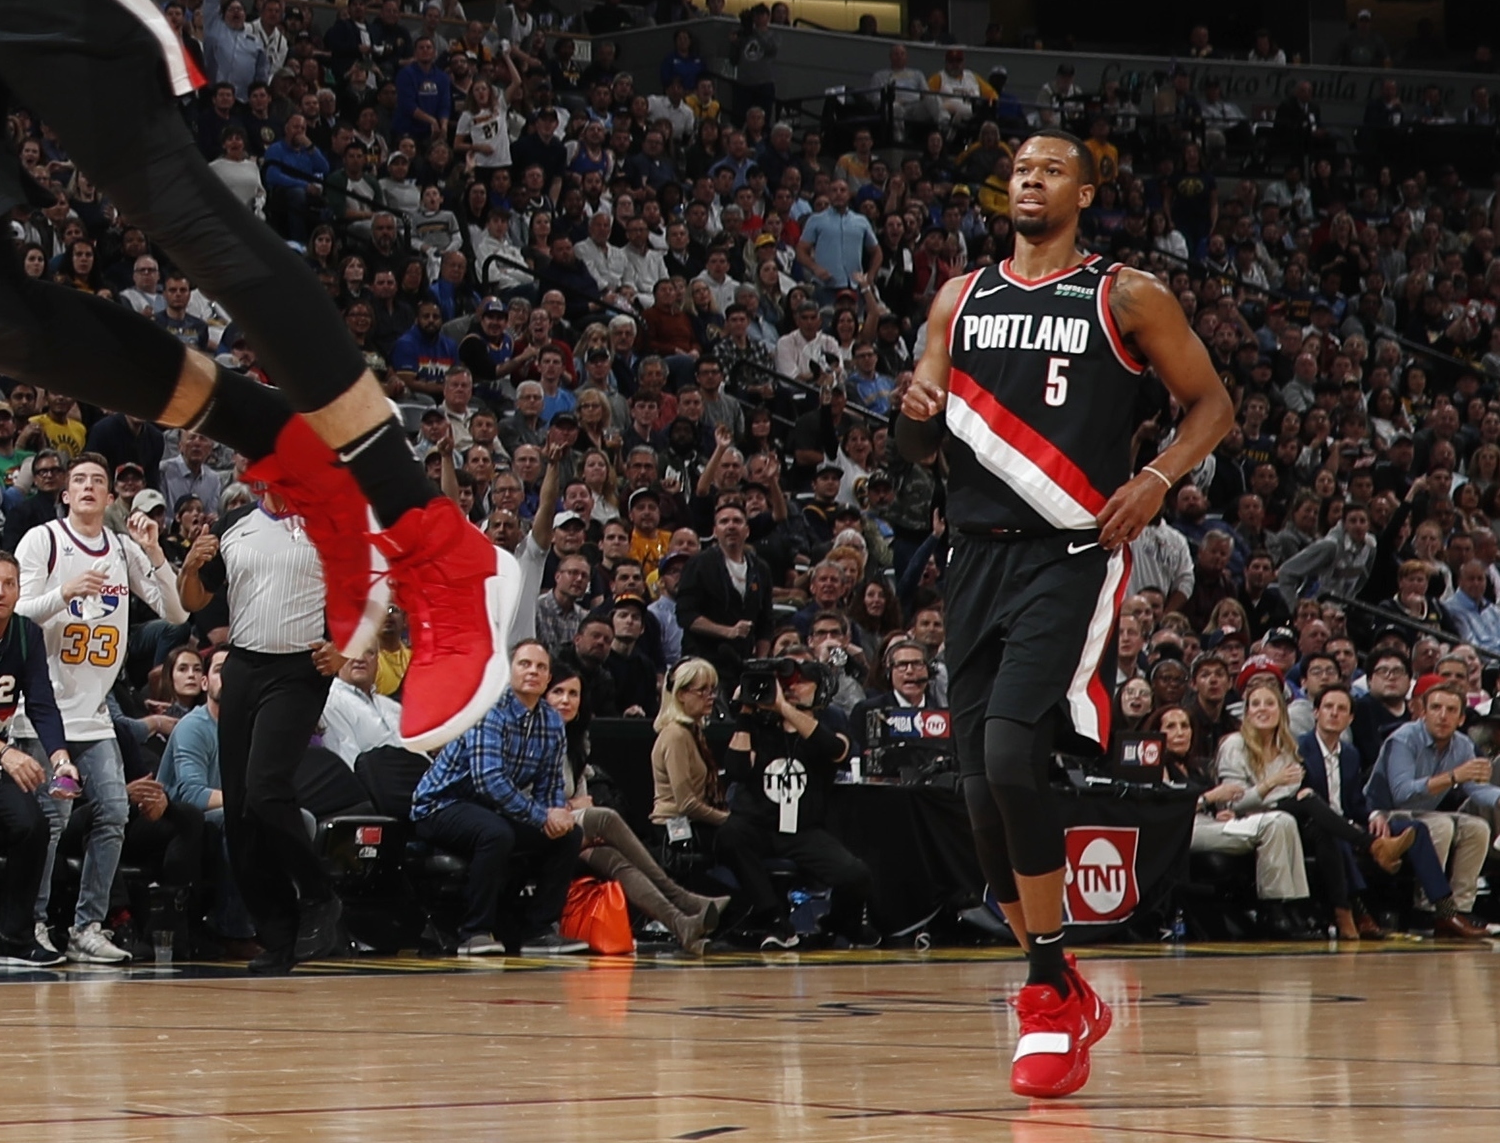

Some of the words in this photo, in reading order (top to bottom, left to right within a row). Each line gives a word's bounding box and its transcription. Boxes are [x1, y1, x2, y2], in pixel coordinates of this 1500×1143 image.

[962, 314, 1090, 355] PORTLAND
[1044, 357, 1071, 407] 5
[60, 623, 120, 669] 33
[764, 770, 808, 791] TNT
[1077, 865, 1127, 894] TNT
